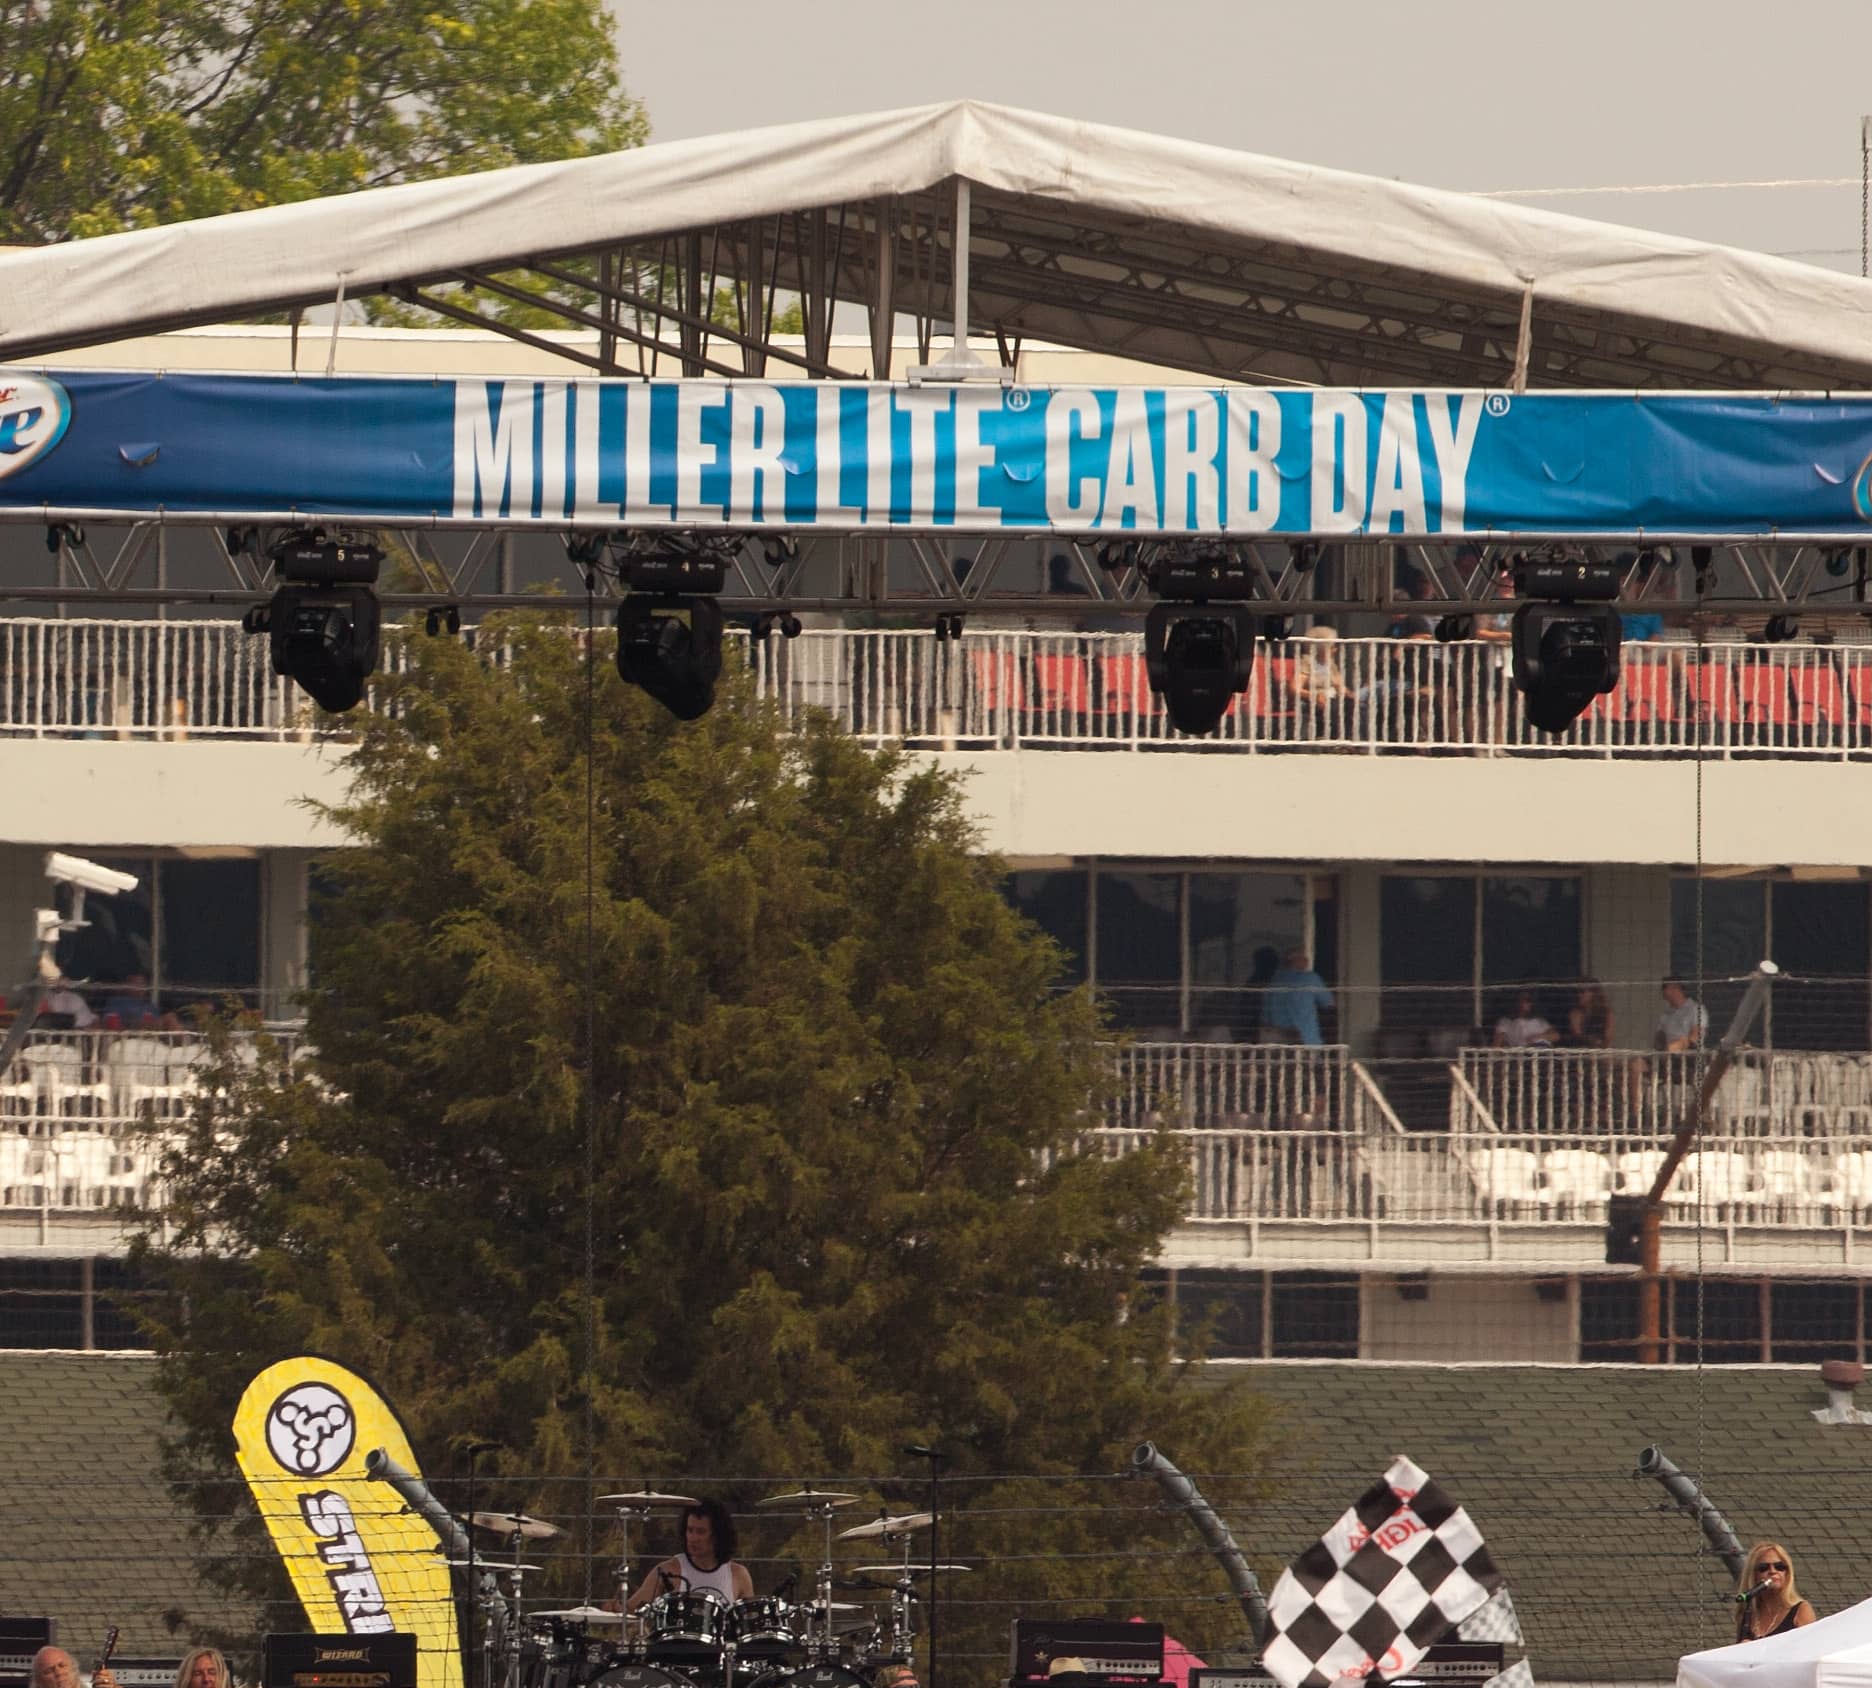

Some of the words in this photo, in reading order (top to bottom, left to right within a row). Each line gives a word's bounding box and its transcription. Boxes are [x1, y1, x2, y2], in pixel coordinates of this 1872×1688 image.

[453, 382, 788, 523] MILLER
[1045, 389, 1281, 533] CARB
[321, 1650, 363, 1660] WIZARD
